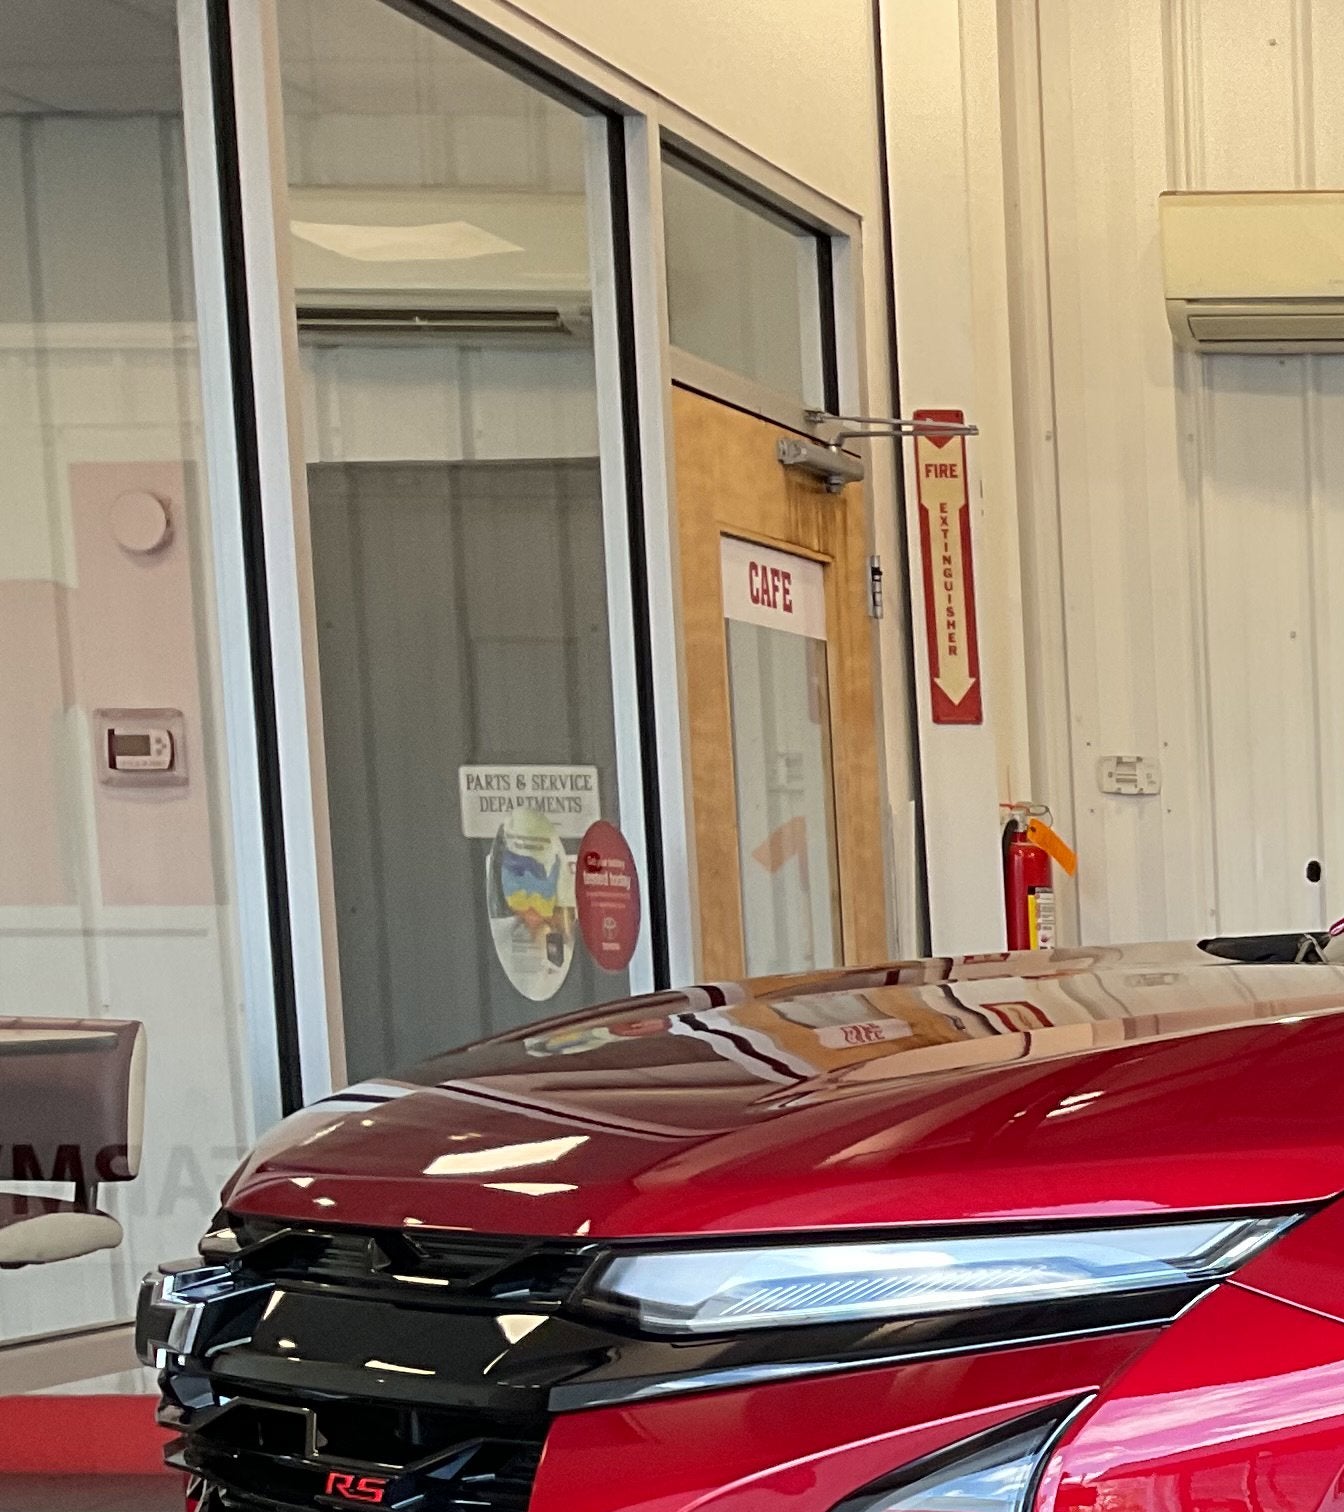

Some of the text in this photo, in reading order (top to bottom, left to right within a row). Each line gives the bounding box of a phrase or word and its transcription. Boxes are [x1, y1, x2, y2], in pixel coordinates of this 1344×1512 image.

[924, 463, 959, 479] FIRE
[748, 561, 793, 614] CAFE
[938, 502, 958, 658] EXTINGUISHER
[466, 773, 593, 791] PARTS & SERVICE
[325, 1472, 389, 1503] RS
